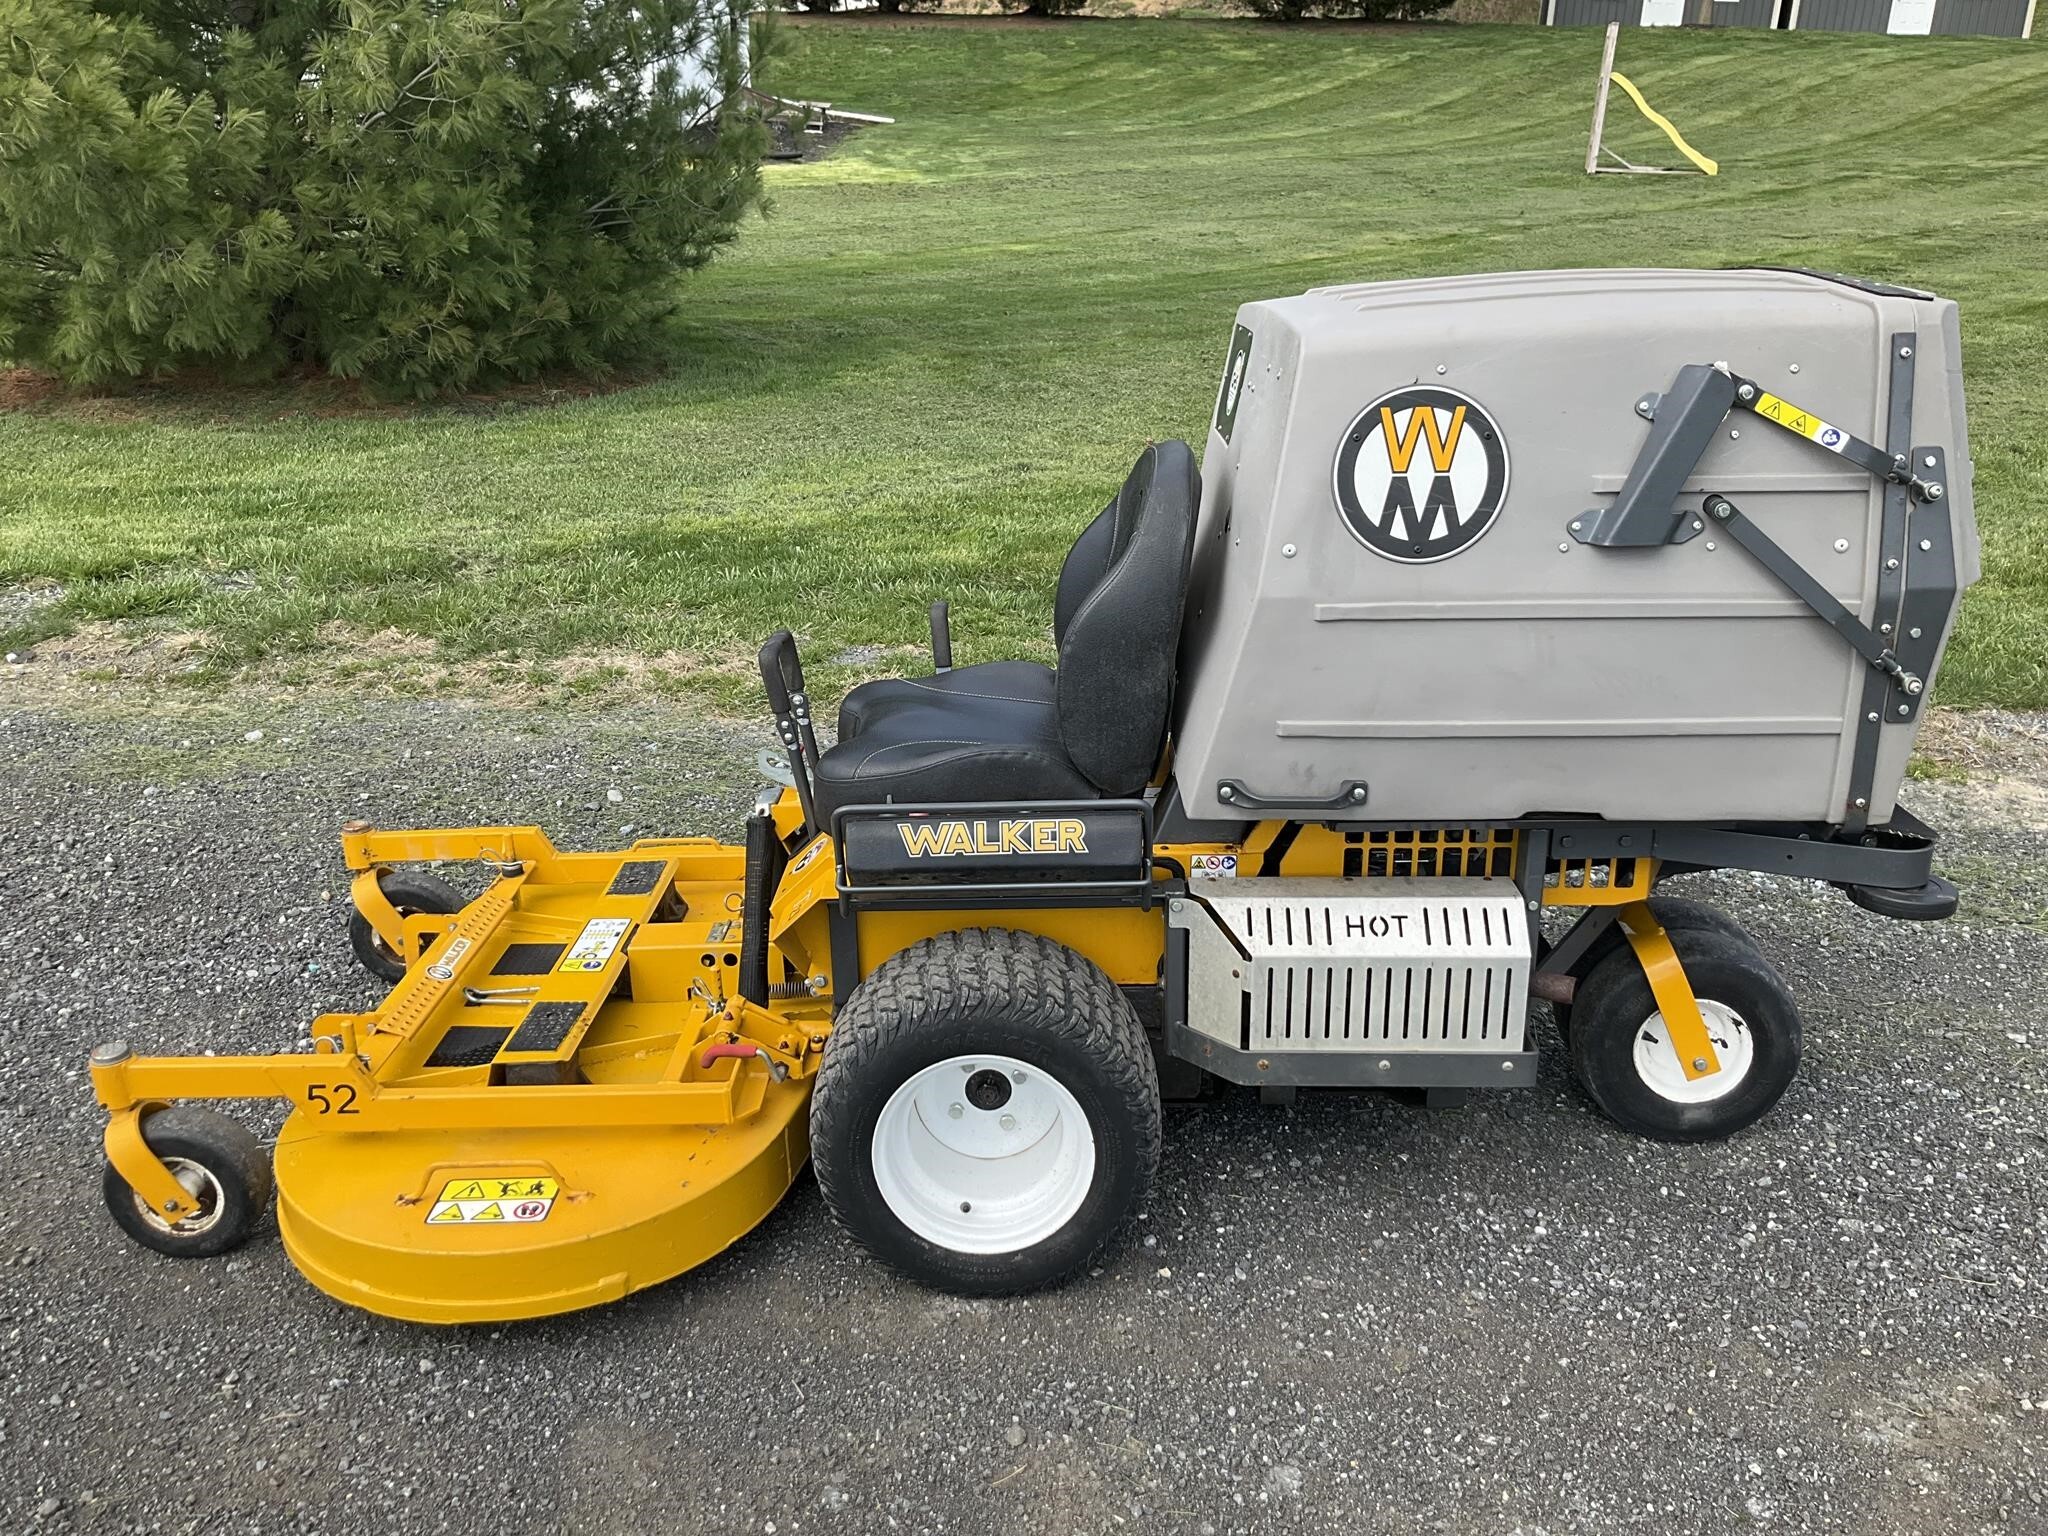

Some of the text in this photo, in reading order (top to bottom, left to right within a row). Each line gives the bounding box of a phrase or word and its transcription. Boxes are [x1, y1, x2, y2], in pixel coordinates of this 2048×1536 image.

[897, 819, 1089, 857] WALKER
[1345, 915, 1408, 937] HOT
[308, 1084, 360, 1114] 52
